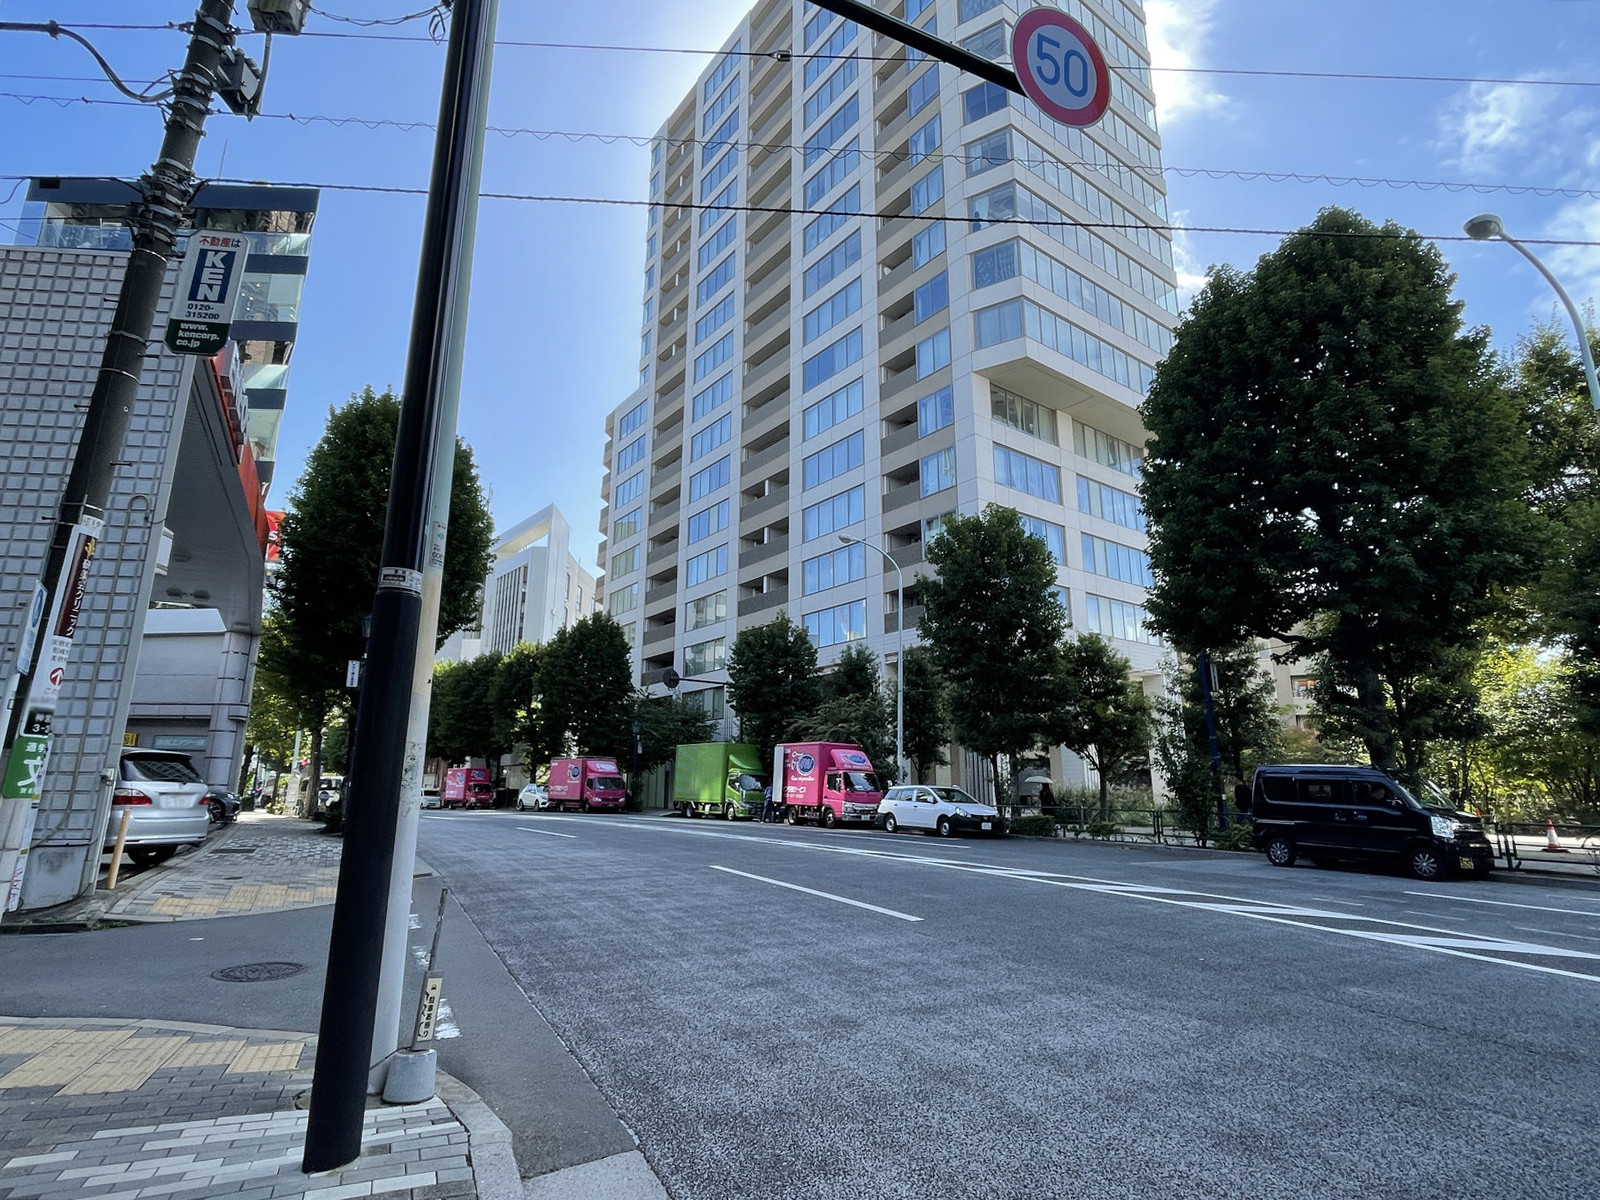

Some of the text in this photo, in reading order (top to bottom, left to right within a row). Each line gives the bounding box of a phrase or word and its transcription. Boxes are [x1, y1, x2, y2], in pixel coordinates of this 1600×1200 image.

[1036, 33, 1088, 98] 50
[199, 235, 241, 248] 不動産は
[196, 251, 228, 302] KEN
[187, 303, 215, 312] 0120-
[185, 310, 220, 321] 315200
[180, 322, 209, 331] www.
[178, 330, 220, 341] kencorp.
[176, 339, 201, 348] co.jp
